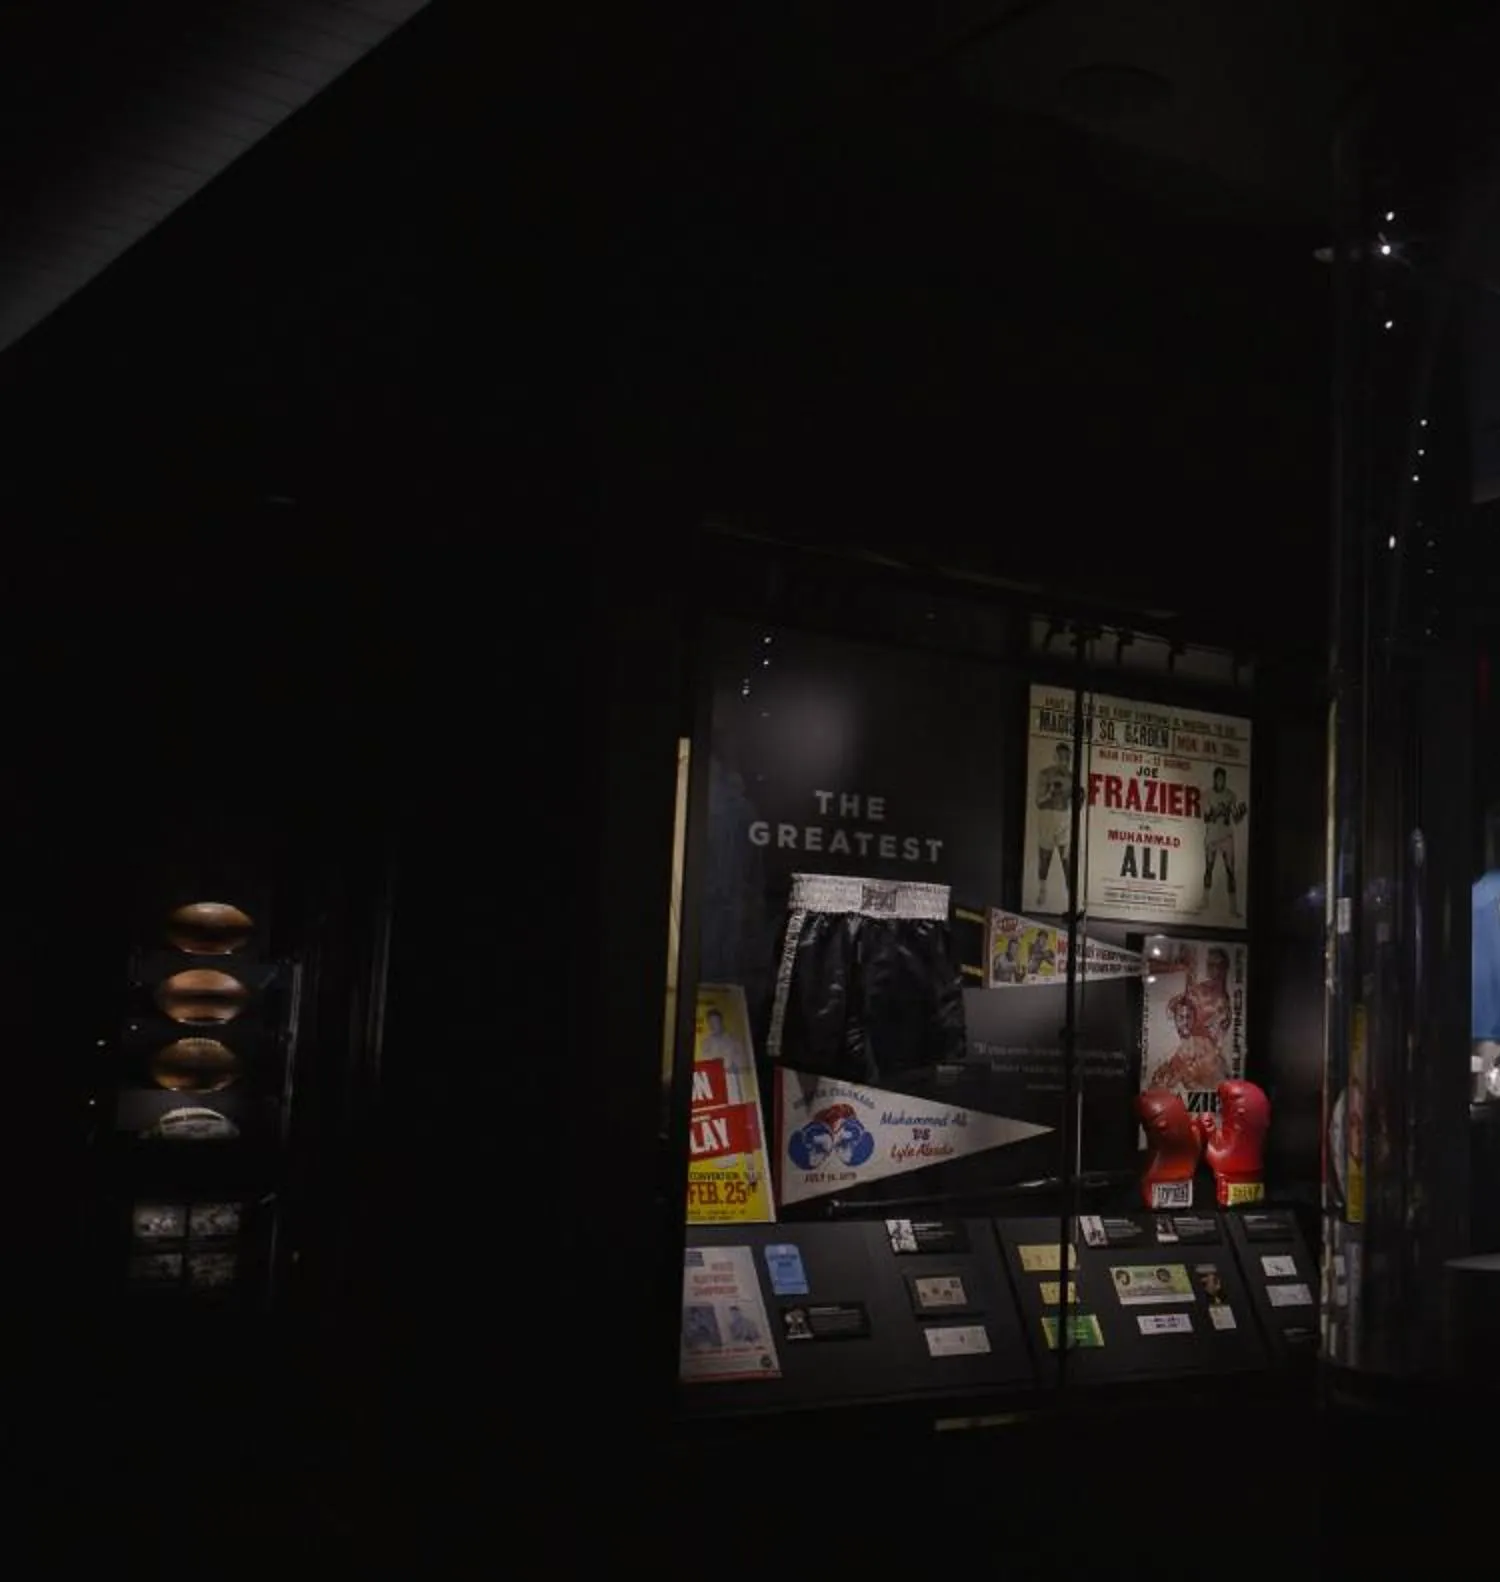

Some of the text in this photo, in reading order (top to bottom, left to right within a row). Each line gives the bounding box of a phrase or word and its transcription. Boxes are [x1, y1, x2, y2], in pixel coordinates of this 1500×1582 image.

[1136, 767, 1159, 779] JOE
[814, 789, 887, 821] THE
[1088, 773, 1201, 819] FRAZIER
[748, 820, 944, 864] GREATEST
[1108, 830, 1181, 848] MUHAMMAD
[1120, 845, 1169, 881] ALI
[689, 1116, 730, 1156] LAY
